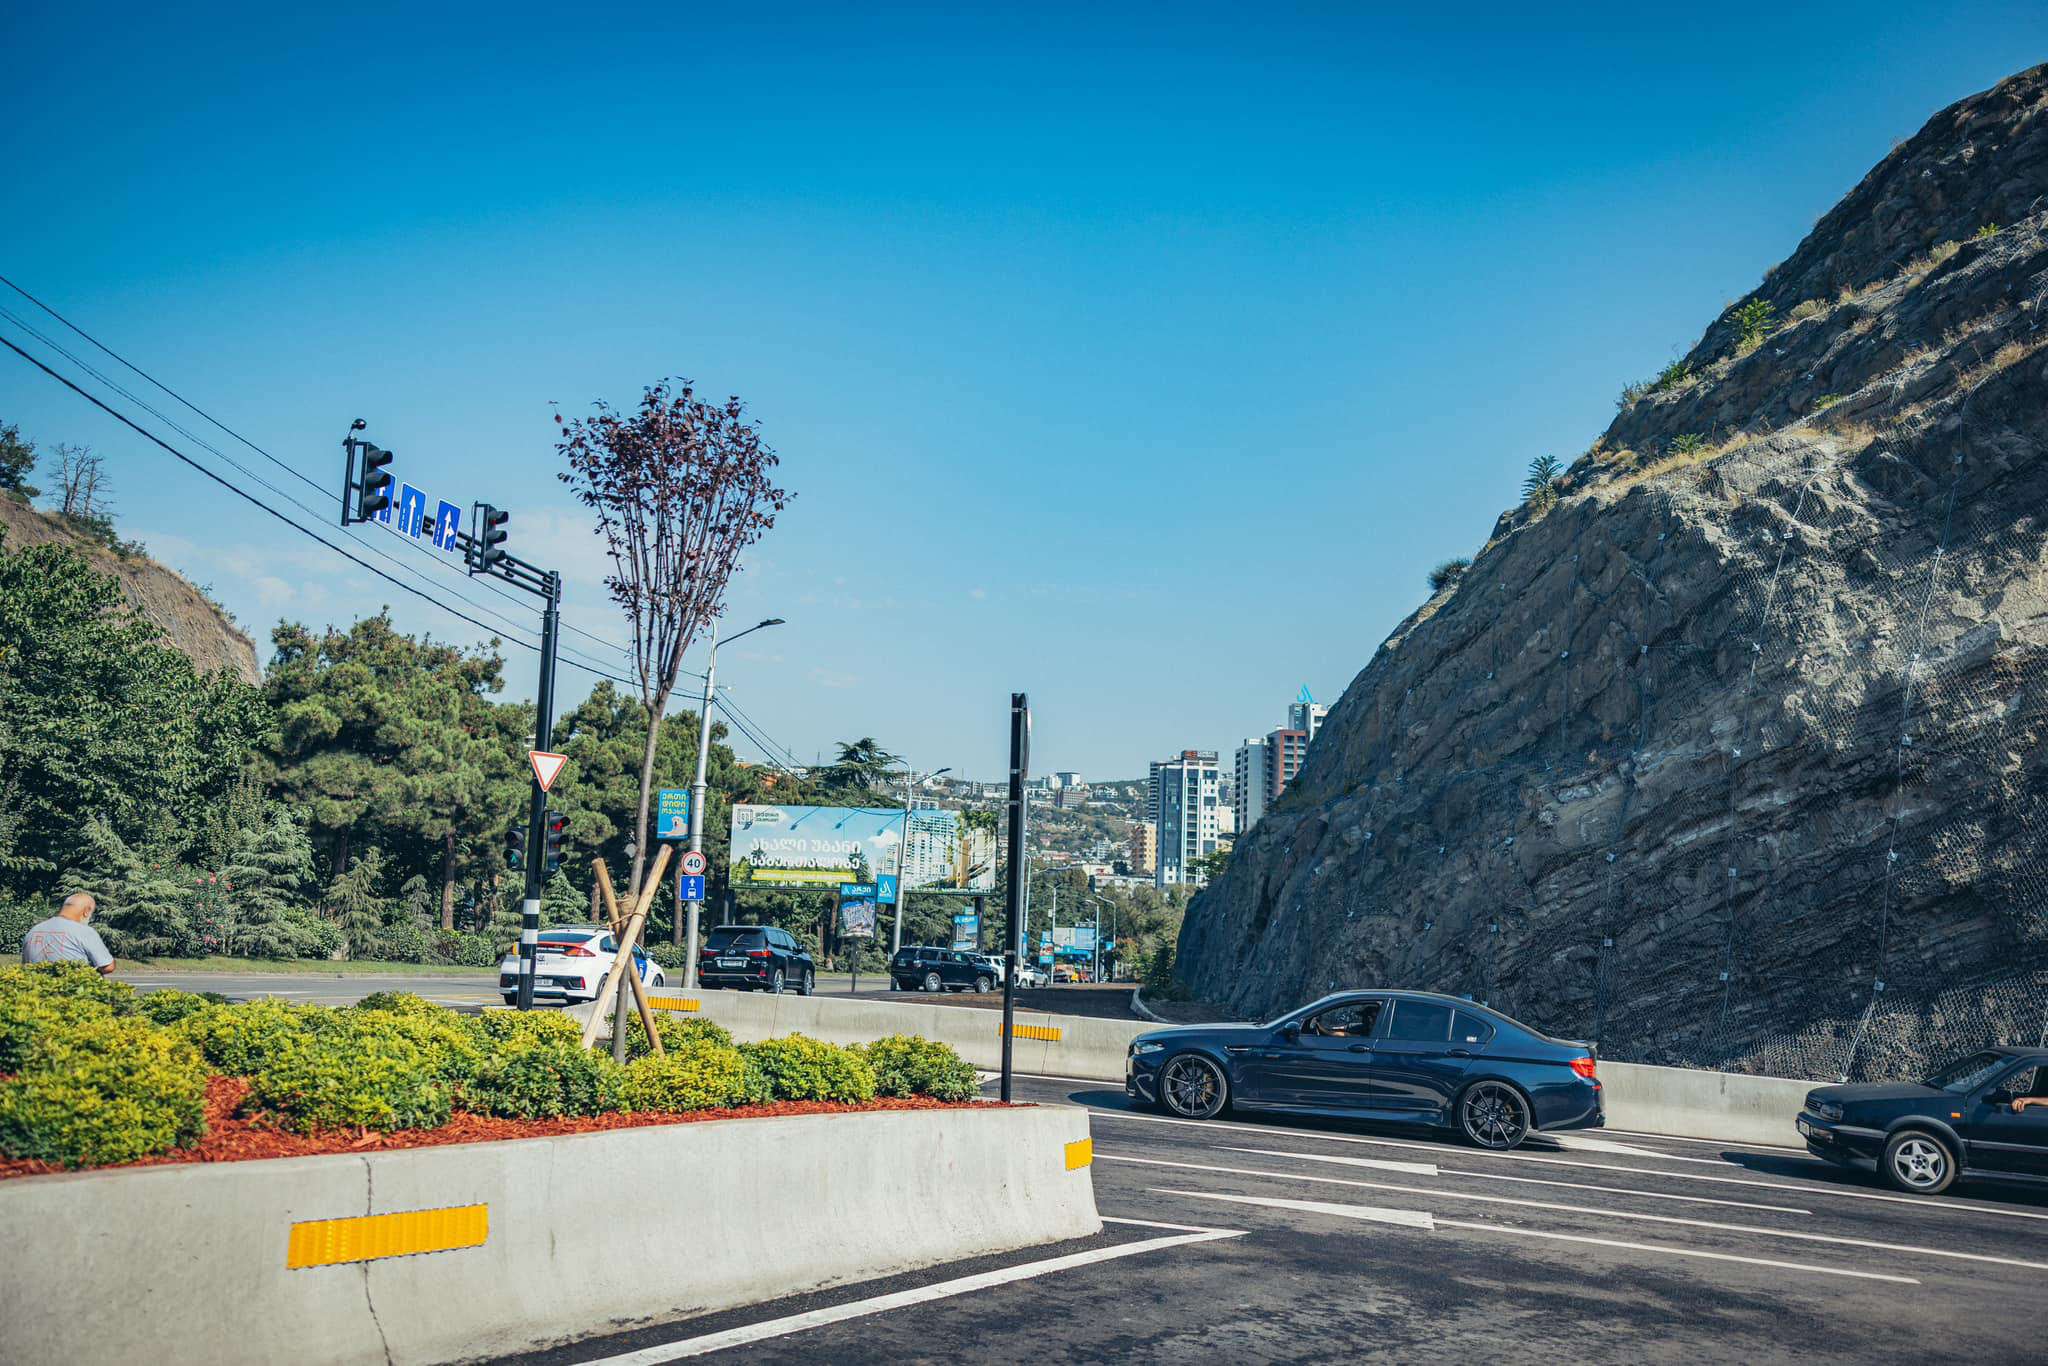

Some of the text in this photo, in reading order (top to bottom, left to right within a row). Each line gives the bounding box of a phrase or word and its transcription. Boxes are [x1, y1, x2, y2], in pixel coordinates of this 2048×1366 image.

[752, 838, 861, 854] ახალი უბანი
[686, 858, 700, 869] 40
